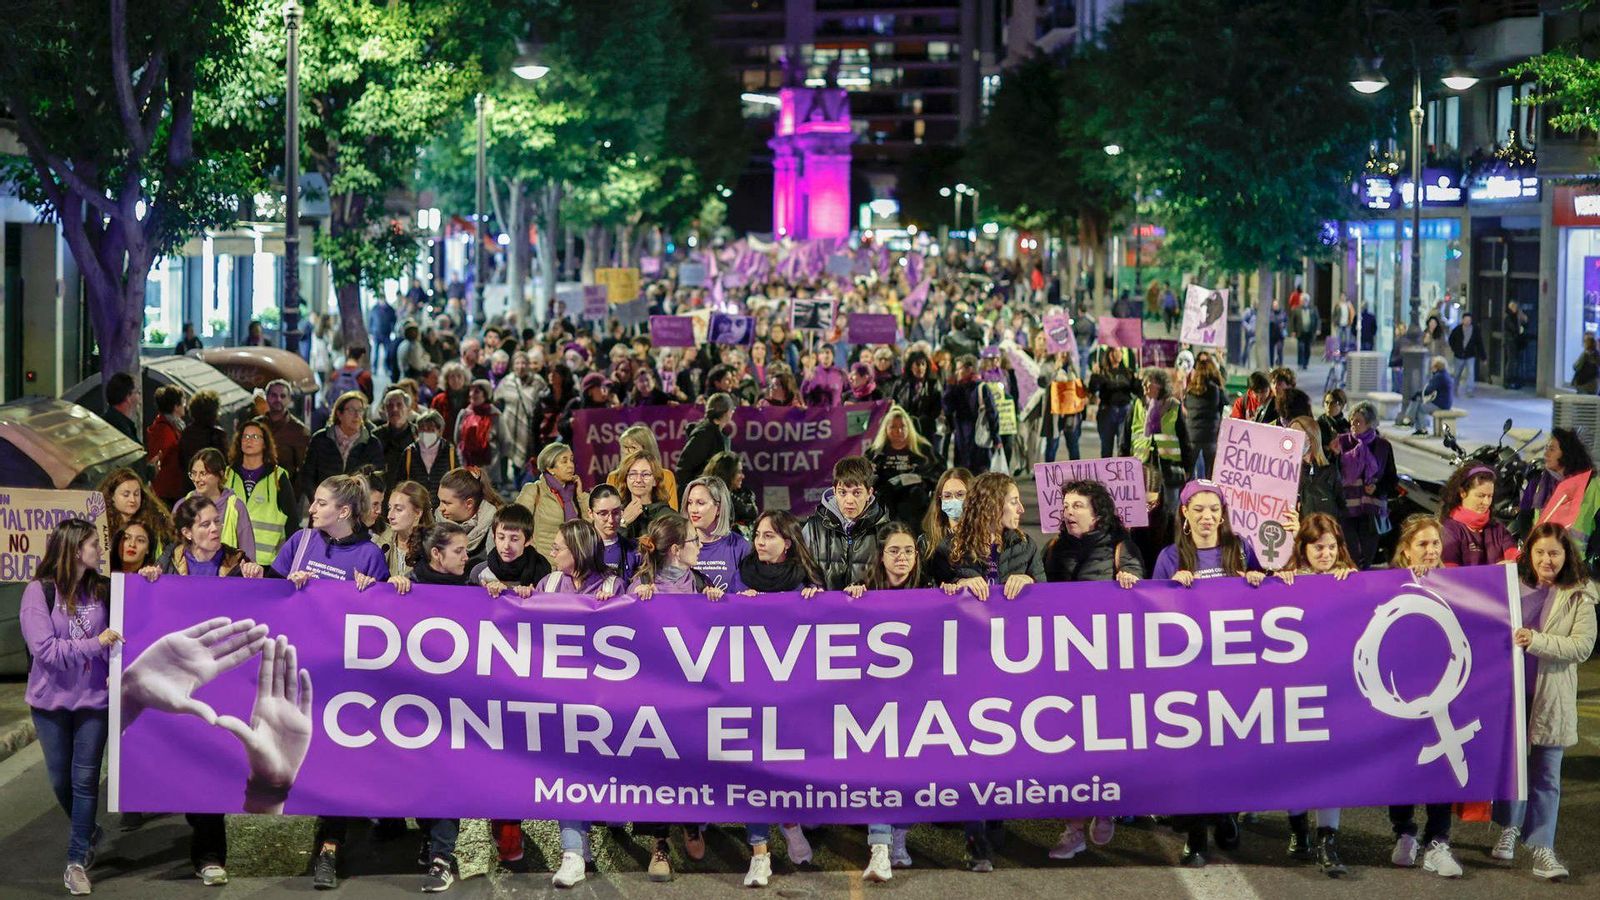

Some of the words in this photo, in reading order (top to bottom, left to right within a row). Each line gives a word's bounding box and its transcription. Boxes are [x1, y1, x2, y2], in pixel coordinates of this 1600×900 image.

[745, 420, 832, 442] DONES
[1228, 425, 1251, 448] LA
[1045, 465, 1063, 487] NO
[1105, 461, 1135, 481] SER
[1223, 445, 1299, 482] REVOLUCIÓN
[1220, 470, 1254, 490] SERÁ
[1109, 485, 1140, 501] VULL
[1232, 509, 1258, 530] NO
[9, 534, 29, 553] NO
[343, 613, 641, 682] DONES
[662, 621, 914, 683] VIVES
[942, 619, 958, 676] I
[990, 605, 1309, 674] UNIDES
[322, 691, 680, 759] CONTRA
[707, 706, 806, 762] EL
[833, 685, 1330, 760] MASCLISME
[534, 776, 715, 806] Moviment
[727, 782, 902, 808] Feminista
[914, 782, 960, 807] de
[968, 775, 1121, 805] València
